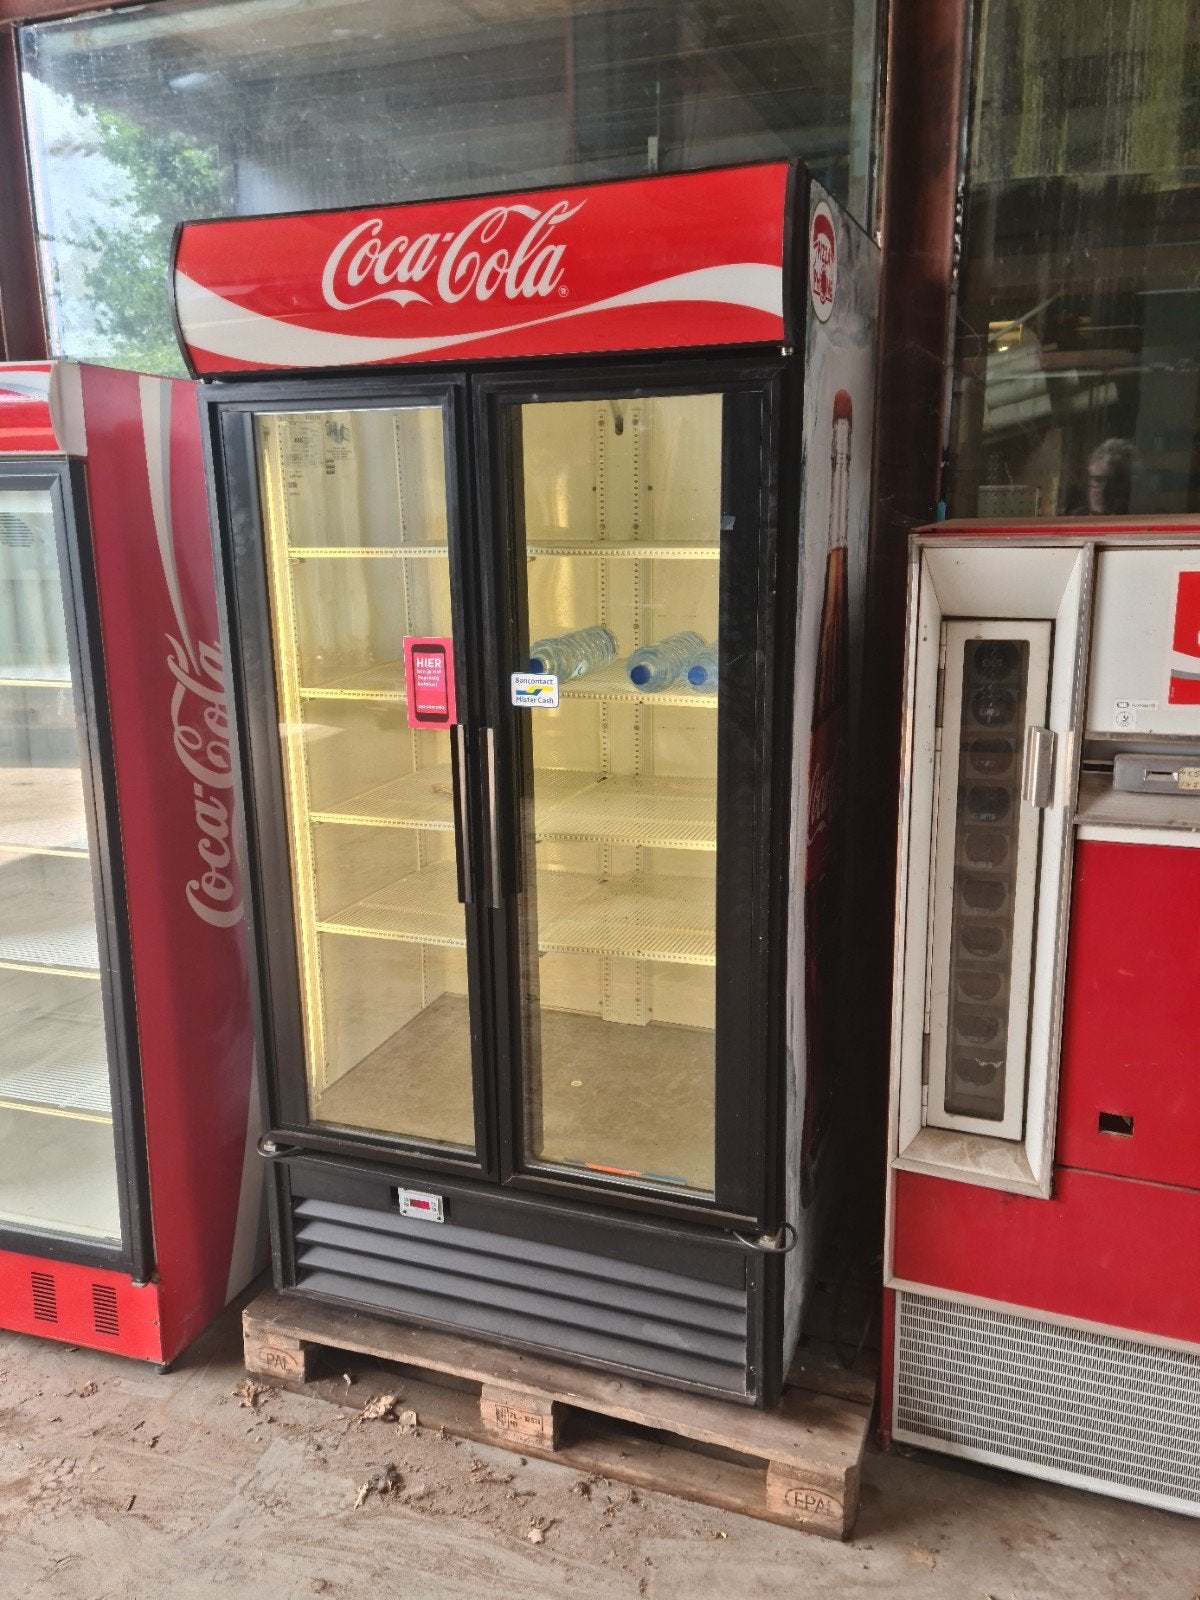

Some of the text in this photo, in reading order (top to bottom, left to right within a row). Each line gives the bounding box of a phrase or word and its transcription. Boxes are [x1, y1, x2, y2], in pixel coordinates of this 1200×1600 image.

[321, 198, 588, 311] Coca-Cola
[416, 657, 441, 668] HIER
[515, 676, 554, 685] Bancontact
[515, 696, 554, 704] Mister Cash
[165, 632, 245, 928] Coca-Cola
